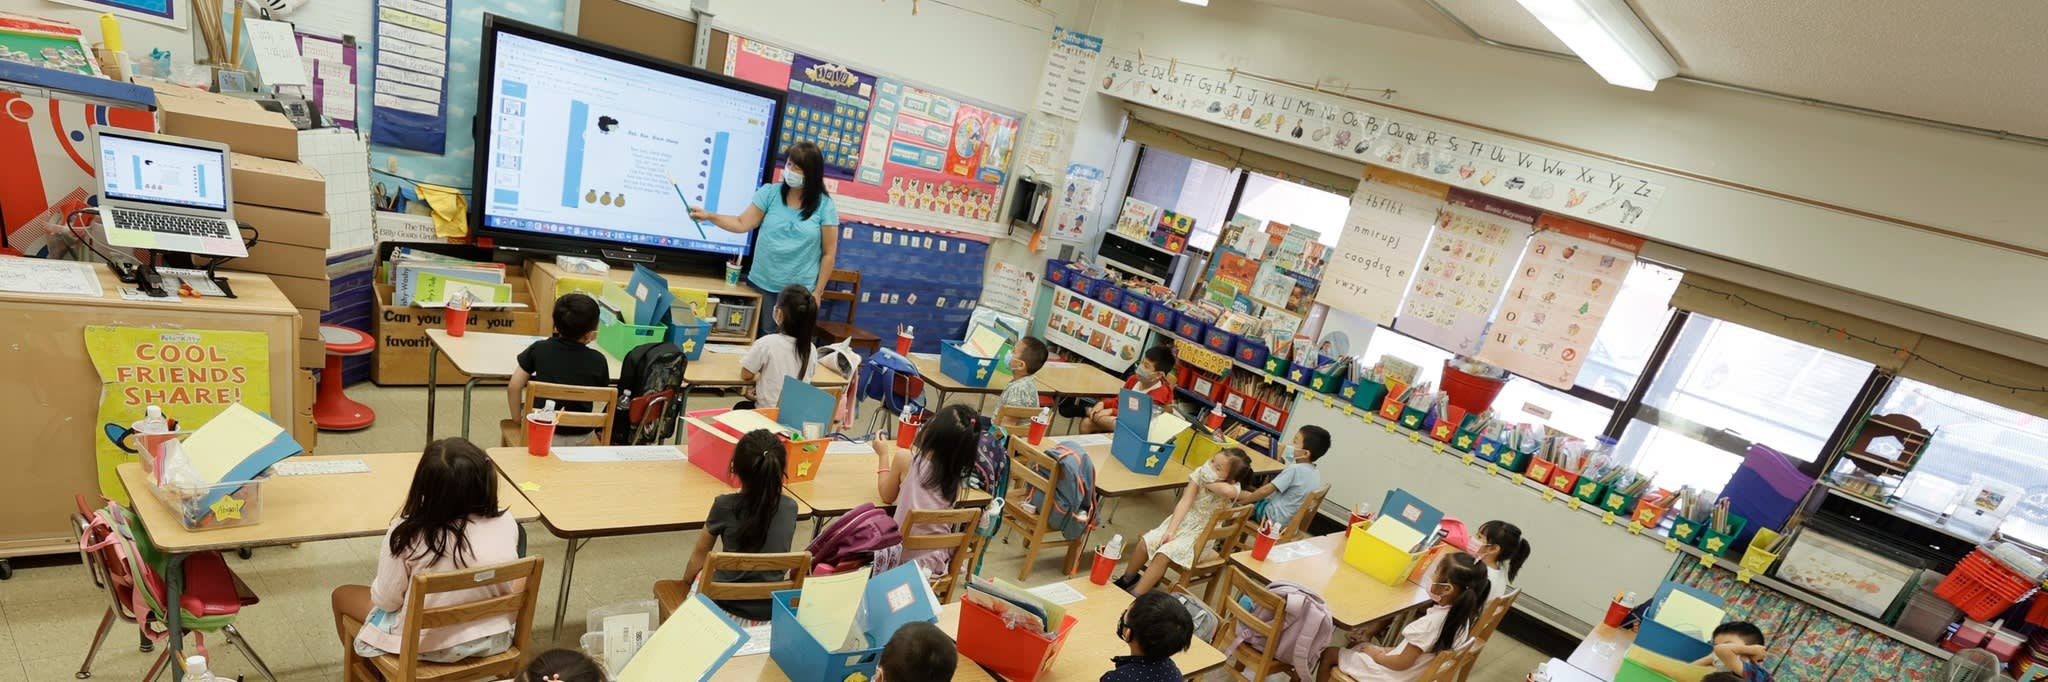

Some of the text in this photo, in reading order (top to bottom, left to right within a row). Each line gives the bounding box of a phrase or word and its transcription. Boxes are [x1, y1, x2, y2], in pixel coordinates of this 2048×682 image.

[304, 45, 336, 61] Family
[817, 67, 849, 83] July
[1108, 56, 1119, 69] Aa
[1123, 59, 1133, 72] Bb
[1151, 66, 1164, 79] Dd
[1183, 73, 1195, 87] Ff
[1198, 77, 1212, 94] Gg
[1215, 80, 1227, 95] Hh
[1247, 88, 1258, 106] Jj
[1262, 92, 1276, 107] Kk
[1296, 100, 1316, 117] Mm
[1320, 106, 1336, 121] Nn
[1342, 111, 1358, 127] Oo
[1365, 116, 1379, 135] Pp
[1425, 131, 1439, 146] Rr
[1446, 136, 1459, 151] Ss
[1469, 141, 1484, 157] Tt
[1490, 146, 1506, 163] Uu
[1518, 152, 1533, 169] Vv
[1542, 158, 1566, 177] Ww
[1575, 166, 1595, 184] Xx
[1609, 173, 1625, 195] Yy
[1634, 180, 1652, 197] Zz
[380, 229, 396, 237] Billy
[397, 230, 417, 239] Goats
[405, 223, 418, 231] The
[1588, 231, 1637, 251] Vowel Sounds
[1536, 244, 1546, 256] a
[1398, 269, 1405, 277] e
[1526, 266, 1536, 277] e
[1518, 287, 1525, 300] i
[384, 310, 411, 323] Can
[417, 313, 441, 326] you
[487, 317, 514, 329] your
[1506, 311, 1516, 322] o
[1496, 332, 1507, 344] u
[136, 343, 227, 363] COOL
[1175, 340, 1231, 368] Classroom
[1179, 350, 1222, 373] Library
[117, 366, 247, 385] FRIENDS
[124, 386, 242, 406] SHARE!
